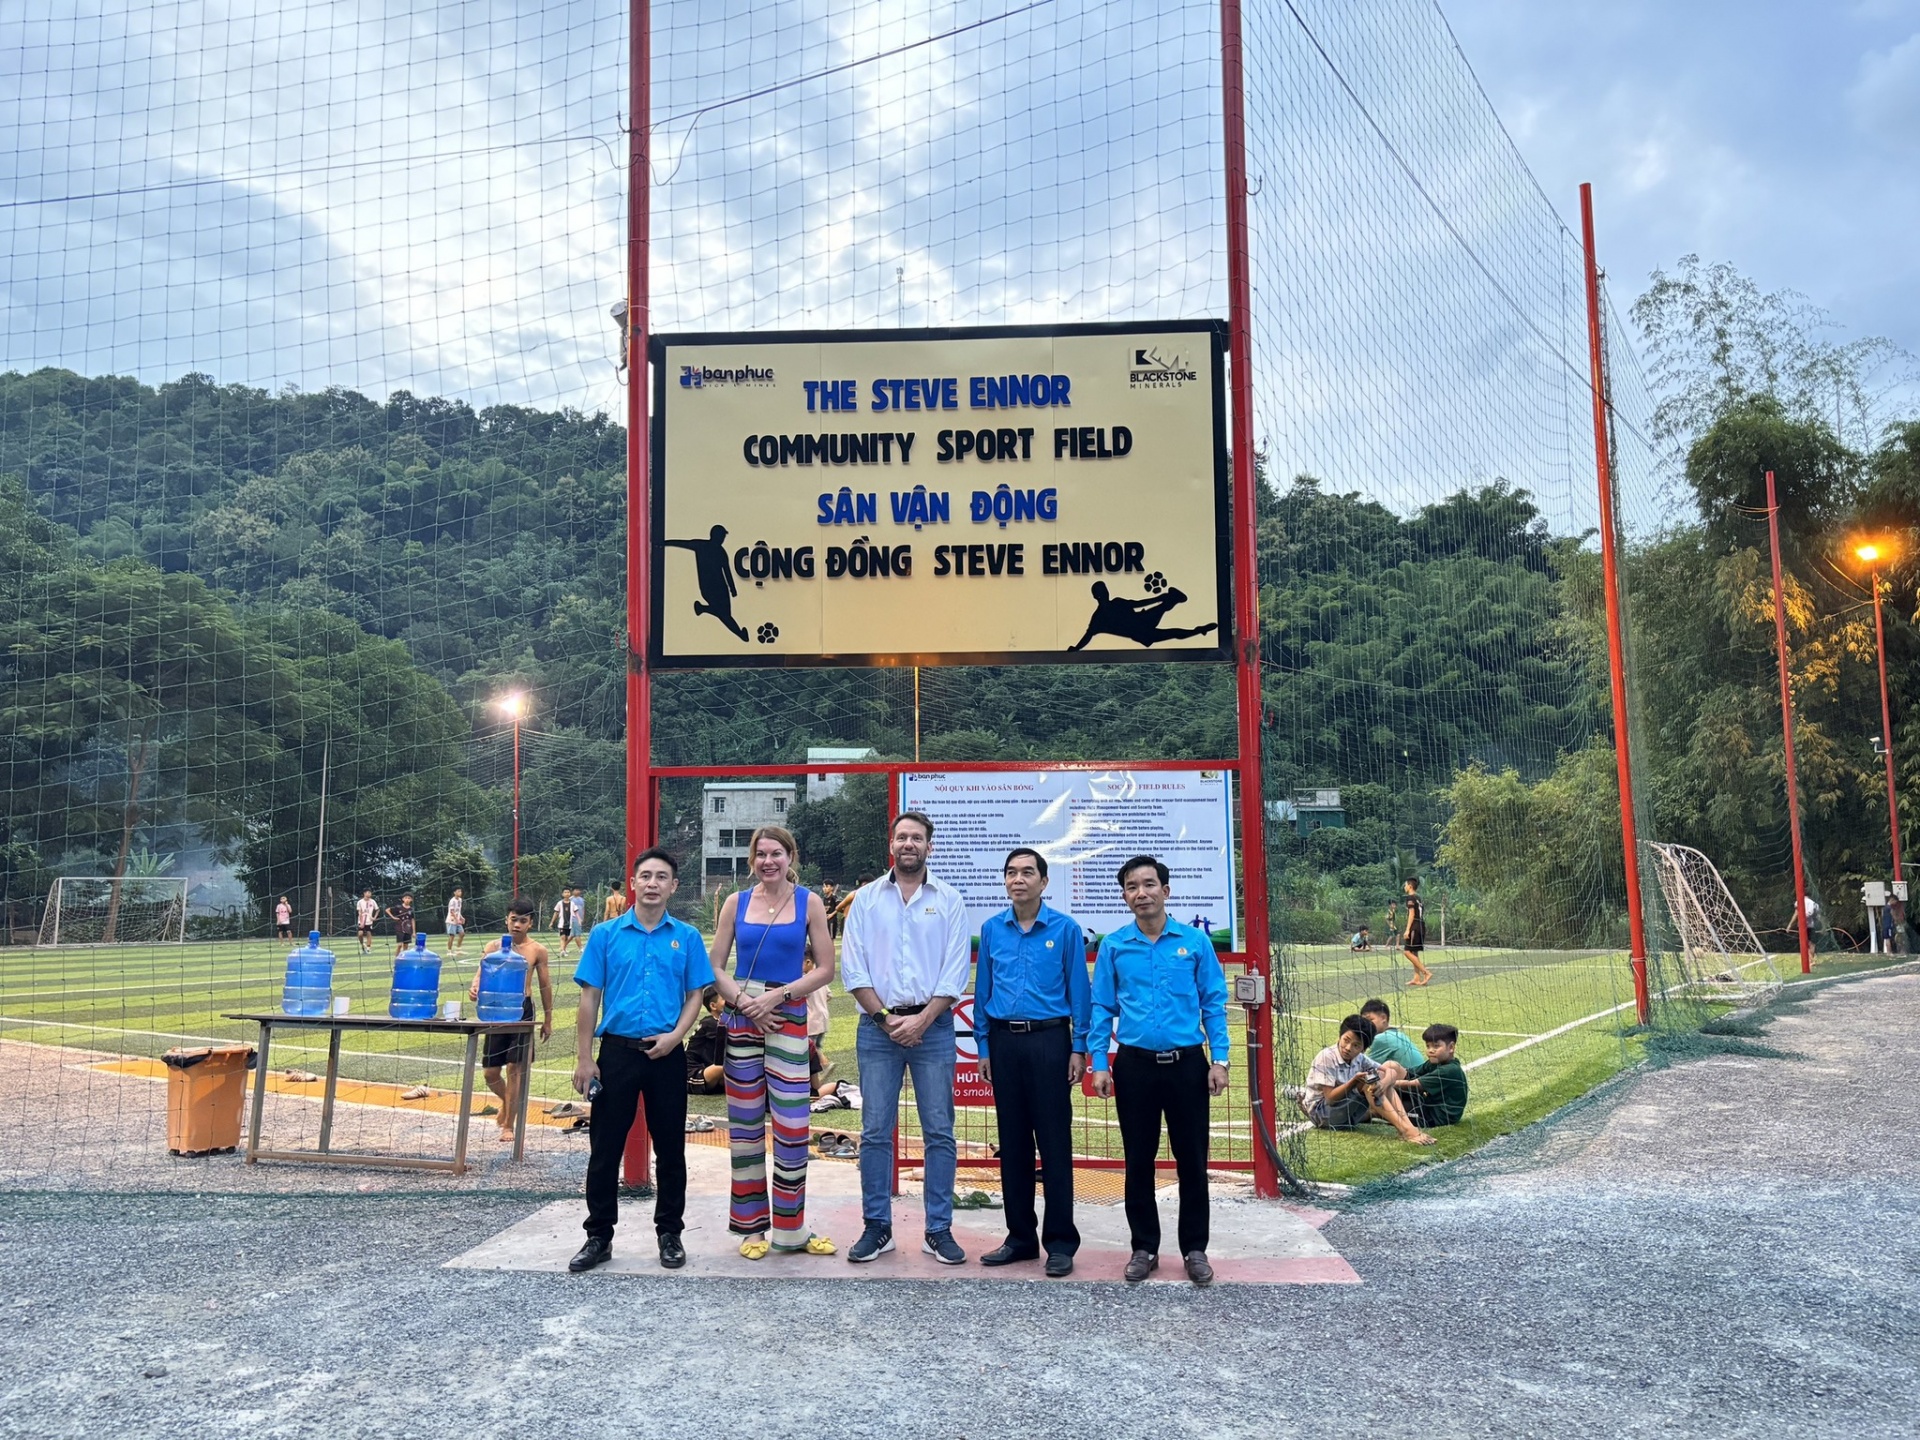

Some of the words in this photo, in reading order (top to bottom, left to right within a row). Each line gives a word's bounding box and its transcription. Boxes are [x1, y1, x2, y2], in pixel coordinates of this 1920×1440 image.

[702, 364, 775, 385] banphuc
[1130, 371, 1197, 383] BLACKSTONE
[803, 380, 856, 413] THE
[872, 378, 957, 412] STEVE
[970, 375, 1070, 410] ENNOR
[1130, 382, 1182, 390] MINERALS
[744, 433, 915, 467] COMMUNITY
[937, 428, 1034, 463] SPORT
[1054, 426, 1132, 460] FIELD
[818, 487, 876, 526] SÂN
[891, 485, 949, 529] VẬN
[970, 484, 1057, 529] ĐỘNG
[733, 540, 815, 588] CỘNG
[825, 536, 911, 578] ĐỒNG
[934, 544, 1024, 576] STEVE
[1042, 541, 1145, 577] ENNOR
[934, 784, 948, 793] NỘI
[949, 785, 964, 793] QUY
[982, 783, 997, 792] VÀO
[956, 1070, 980, 1084] HÚT
[963, 1086, 994, 1097] smoki
